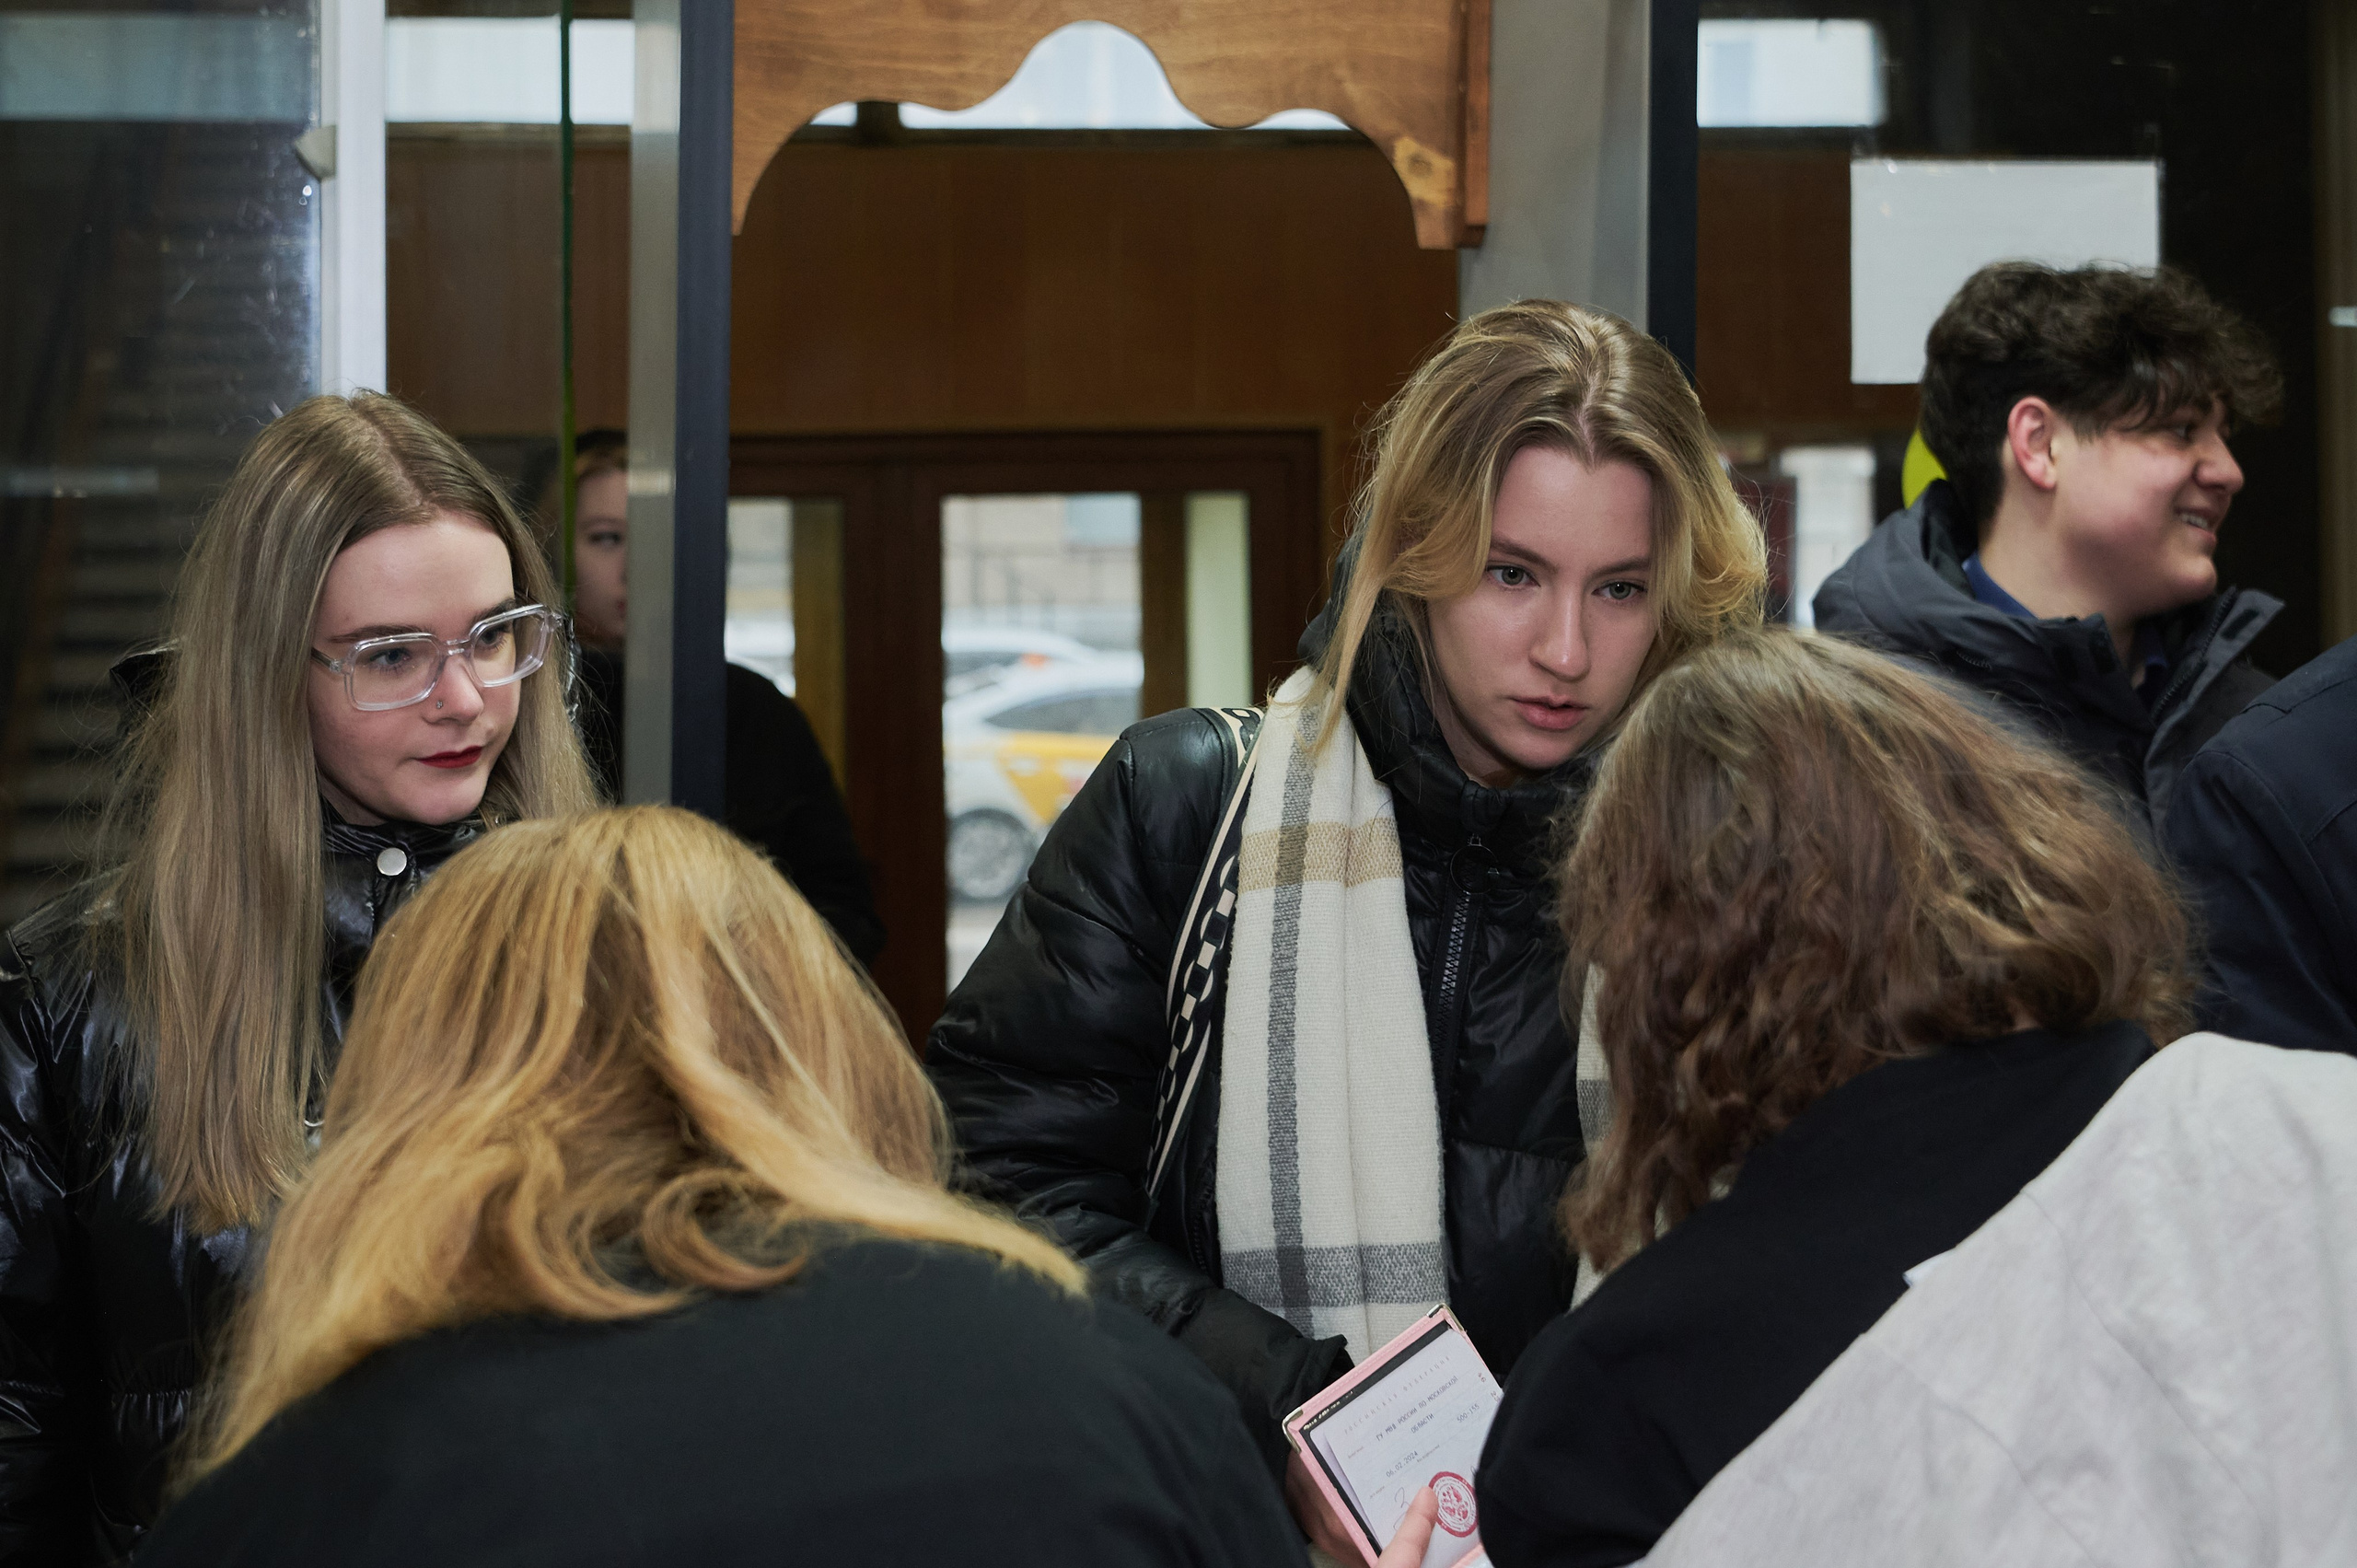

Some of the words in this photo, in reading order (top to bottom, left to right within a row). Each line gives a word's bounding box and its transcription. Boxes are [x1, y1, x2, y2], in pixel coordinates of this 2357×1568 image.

[1376, 1434, 1384, 1442] ГУ
[1397, 1408, 1418, 1424] РОССИИ
[1419, 1400, 1428, 1409] ПО
[1411, 1413, 1434, 1434] ОБЛАСТИ
[1386, 1450, 1418, 1478] 06.02.2024
